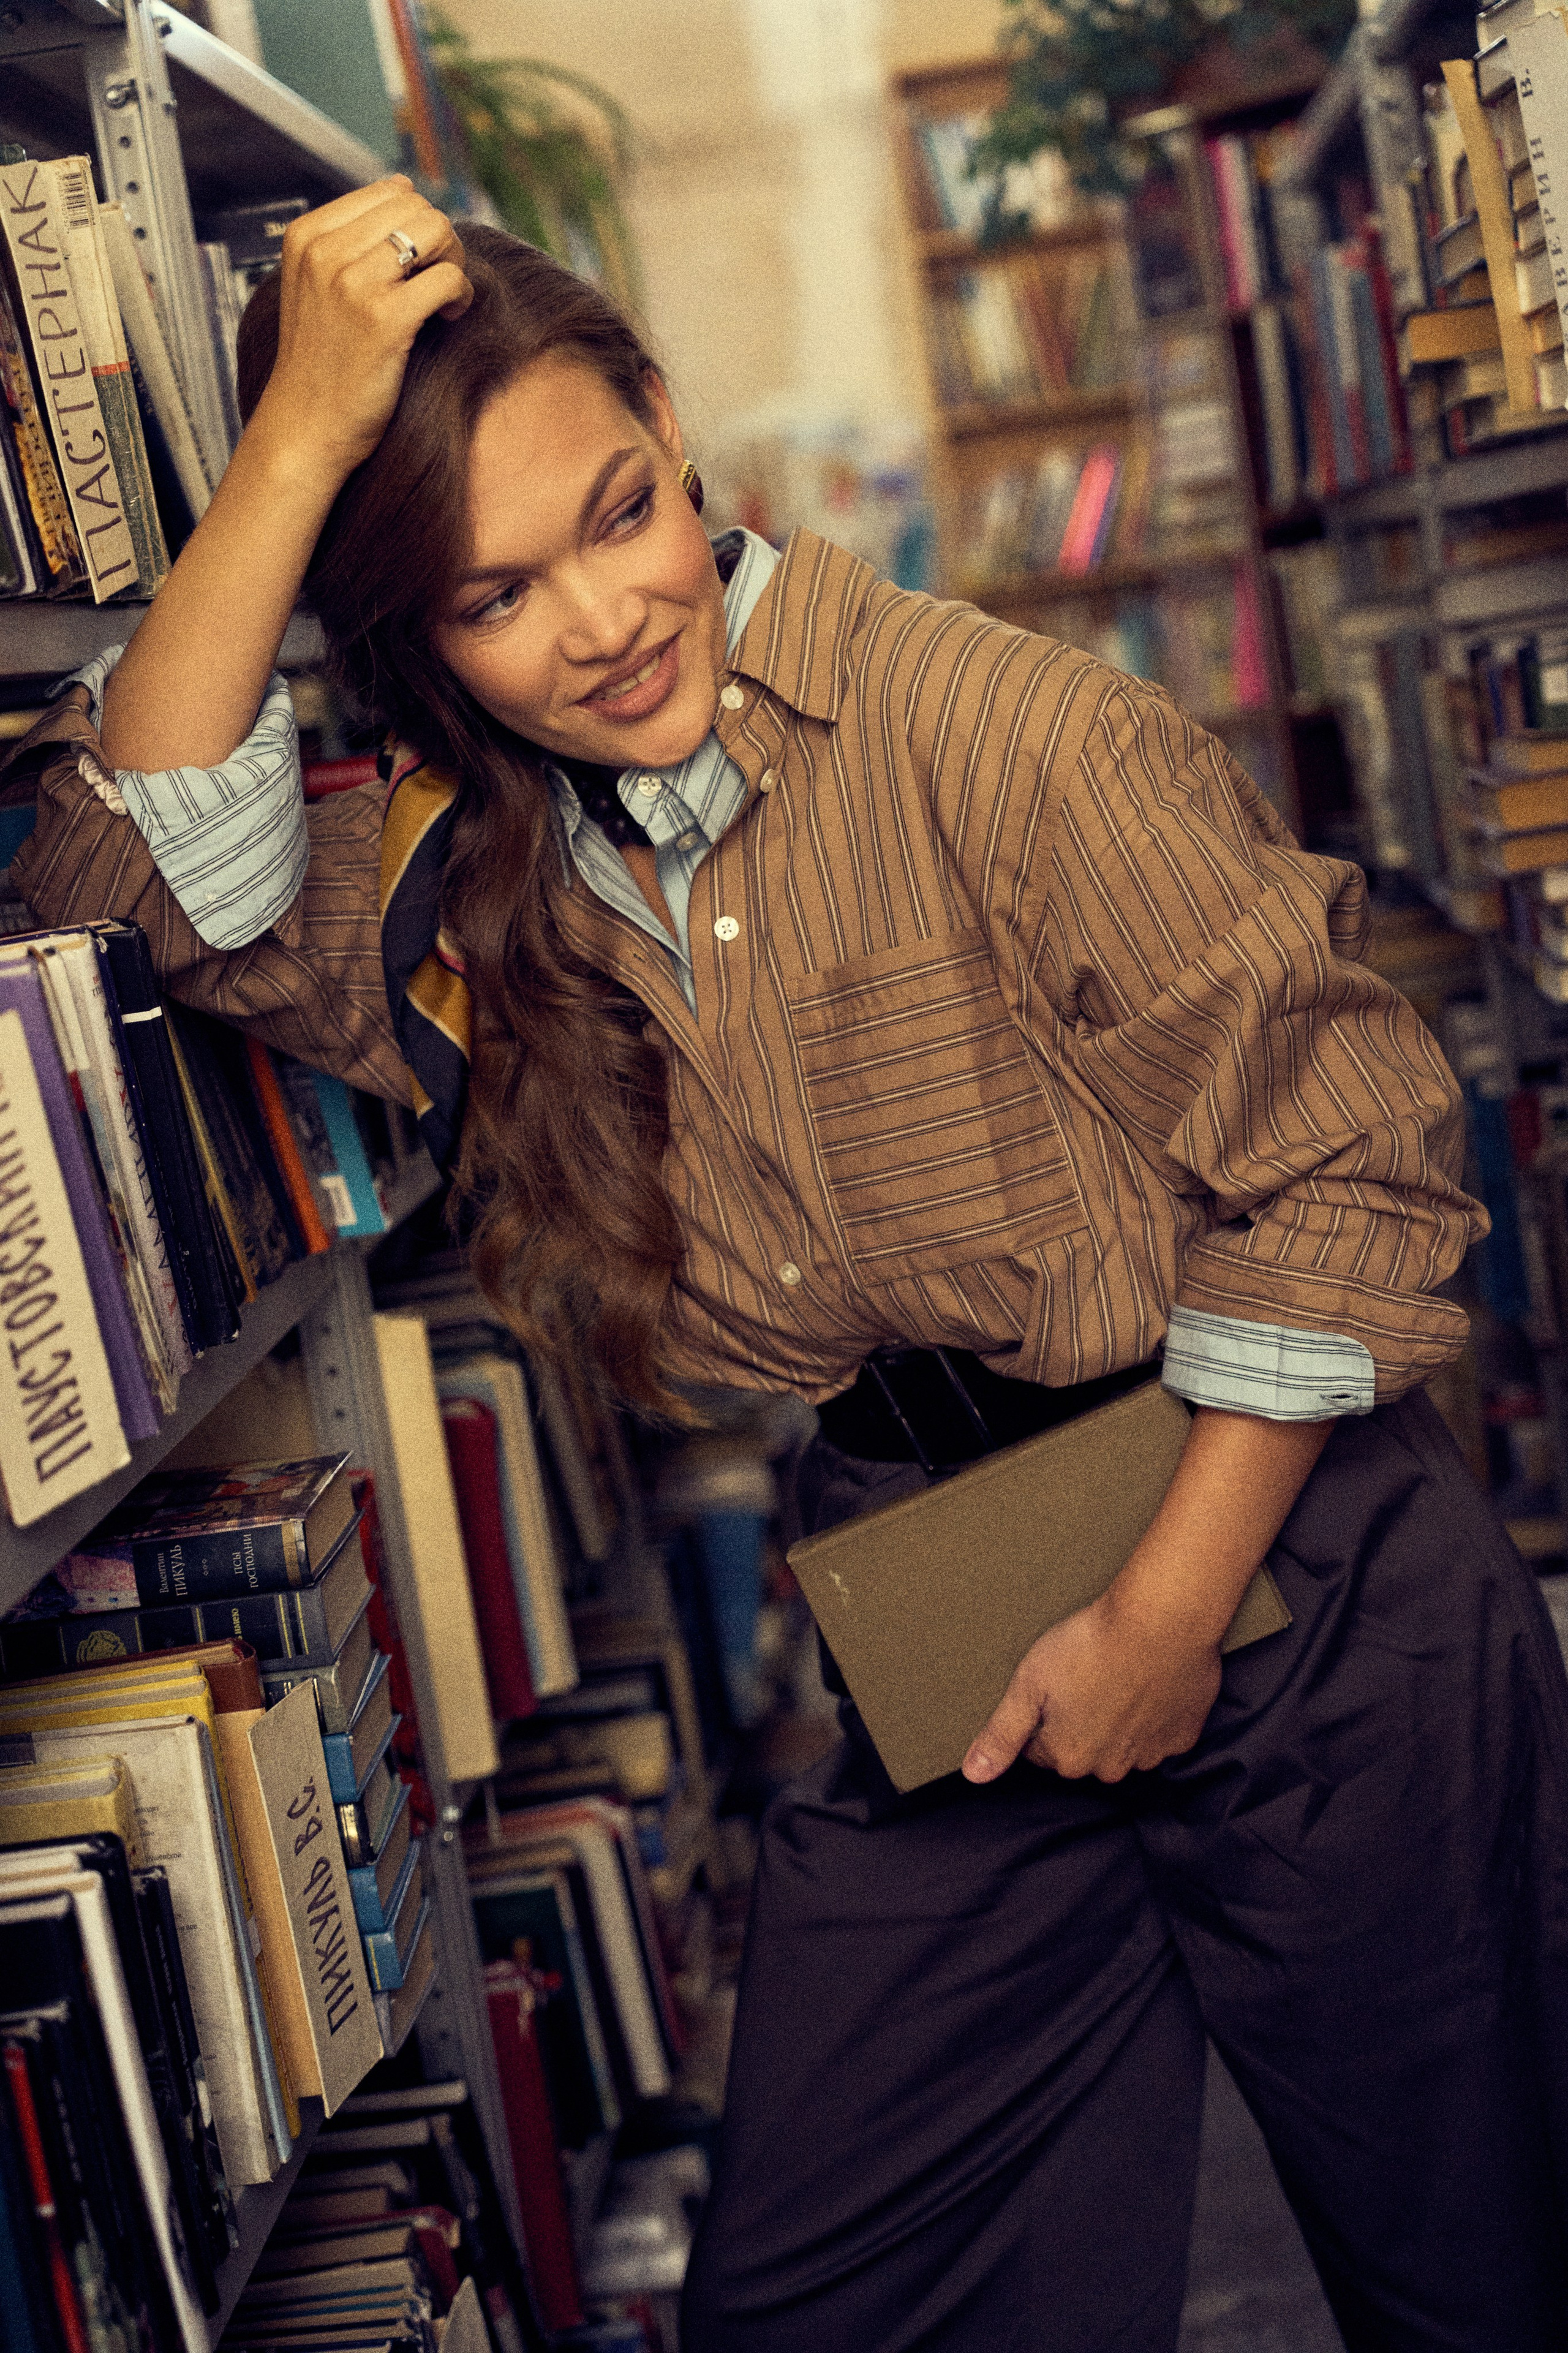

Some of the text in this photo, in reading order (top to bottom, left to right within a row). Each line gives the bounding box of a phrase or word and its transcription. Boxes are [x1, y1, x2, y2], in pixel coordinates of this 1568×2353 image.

[1520, 68, 1533, 97] В.
[2, 166, 130, 583] ПАСТЕРНАК
[157, 1552, 170, 1593] Валентин
[170, 1544, 188, 1596] ПИКУЛЬ
[232, 1552, 243, 1575] ПСЫ
[243, 1533, 259, 1588] ГОСПОДНИ
[304, 1856, 358, 2036] ПИКУЛЬ
